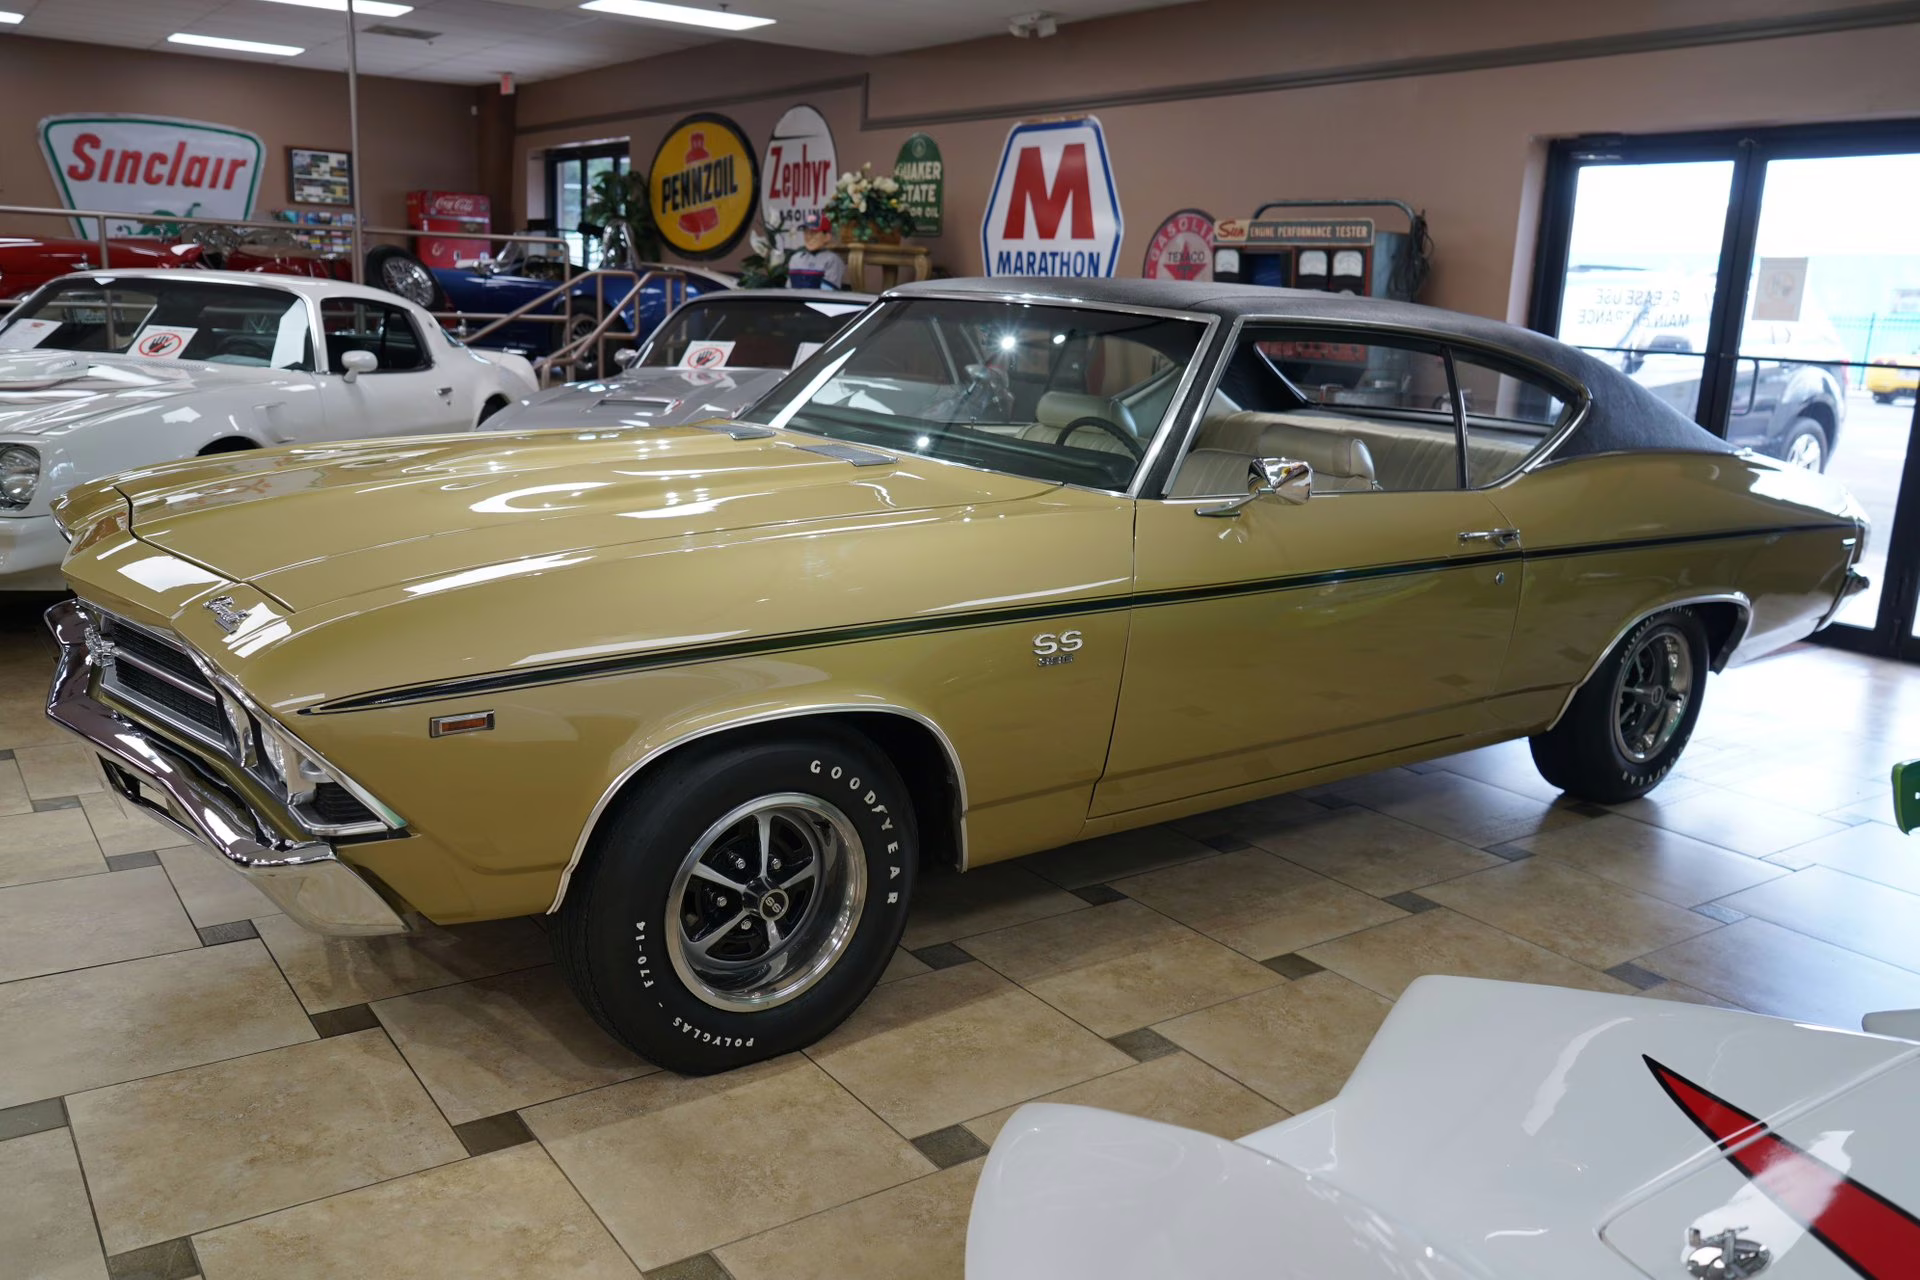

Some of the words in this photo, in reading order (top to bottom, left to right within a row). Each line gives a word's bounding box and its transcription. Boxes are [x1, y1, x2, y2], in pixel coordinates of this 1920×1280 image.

[67, 133, 248, 190] Sinclair
[769, 144, 831, 207] Zephyr
[662, 154, 738, 214] PENNZOIL
[1002, 142, 1096, 240] M
[1218, 219, 1246, 238] Sun
[1250, 225, 1274, 237] ENGINE
[1277, 225, 1332, 238] PERFORMANCE
[1335, 225, 1368, 238] TESTER
[997, 250, 1100, 277] MARATHON
[1168, 251, 1205, 263] TEXACO
[1032, 629, 1084, 655] SS
[810, 759, 900, 904] GOODYEAR
[765, 896, 782, 913] SS
[635, 921, 655, 989] F70-14
[672, 1016, 754, 1047] POLYGLAS
